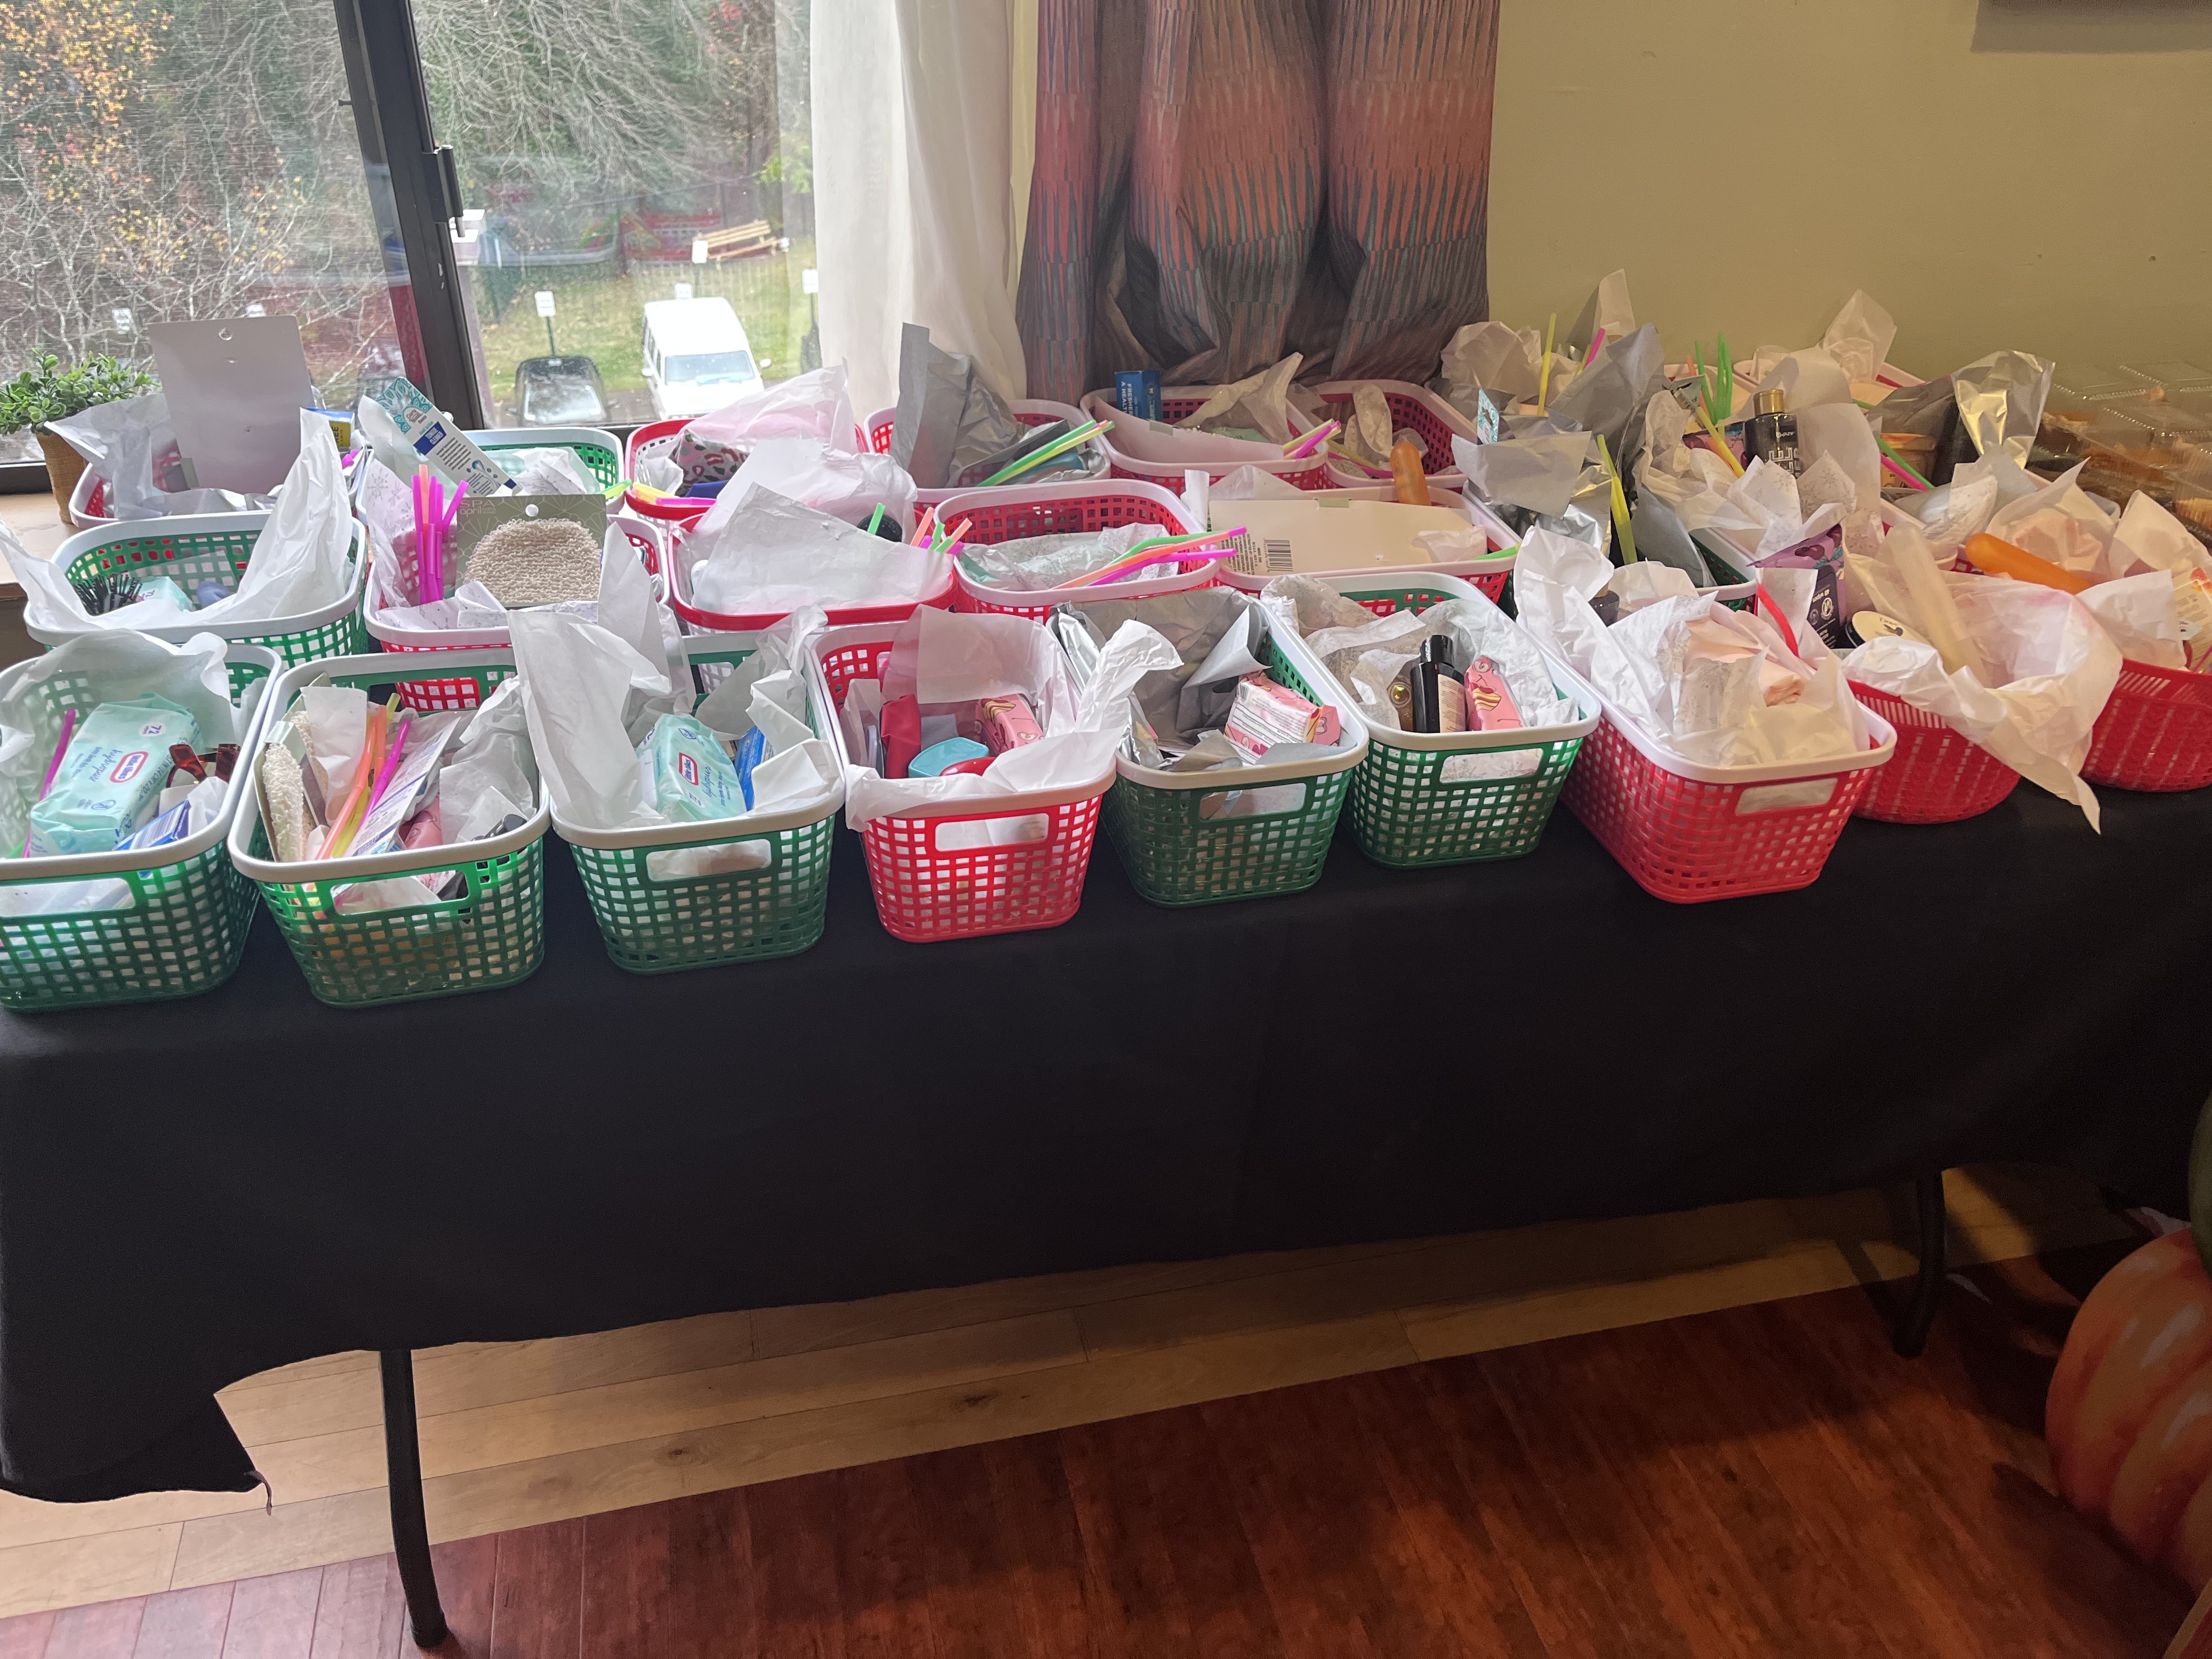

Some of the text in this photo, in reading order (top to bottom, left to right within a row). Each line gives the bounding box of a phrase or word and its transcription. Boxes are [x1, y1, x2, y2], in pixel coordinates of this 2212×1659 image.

[460, 499, 495, 508] SPA
[460, 505, 482, 518] april
[148, 725, 162, 735] 72
